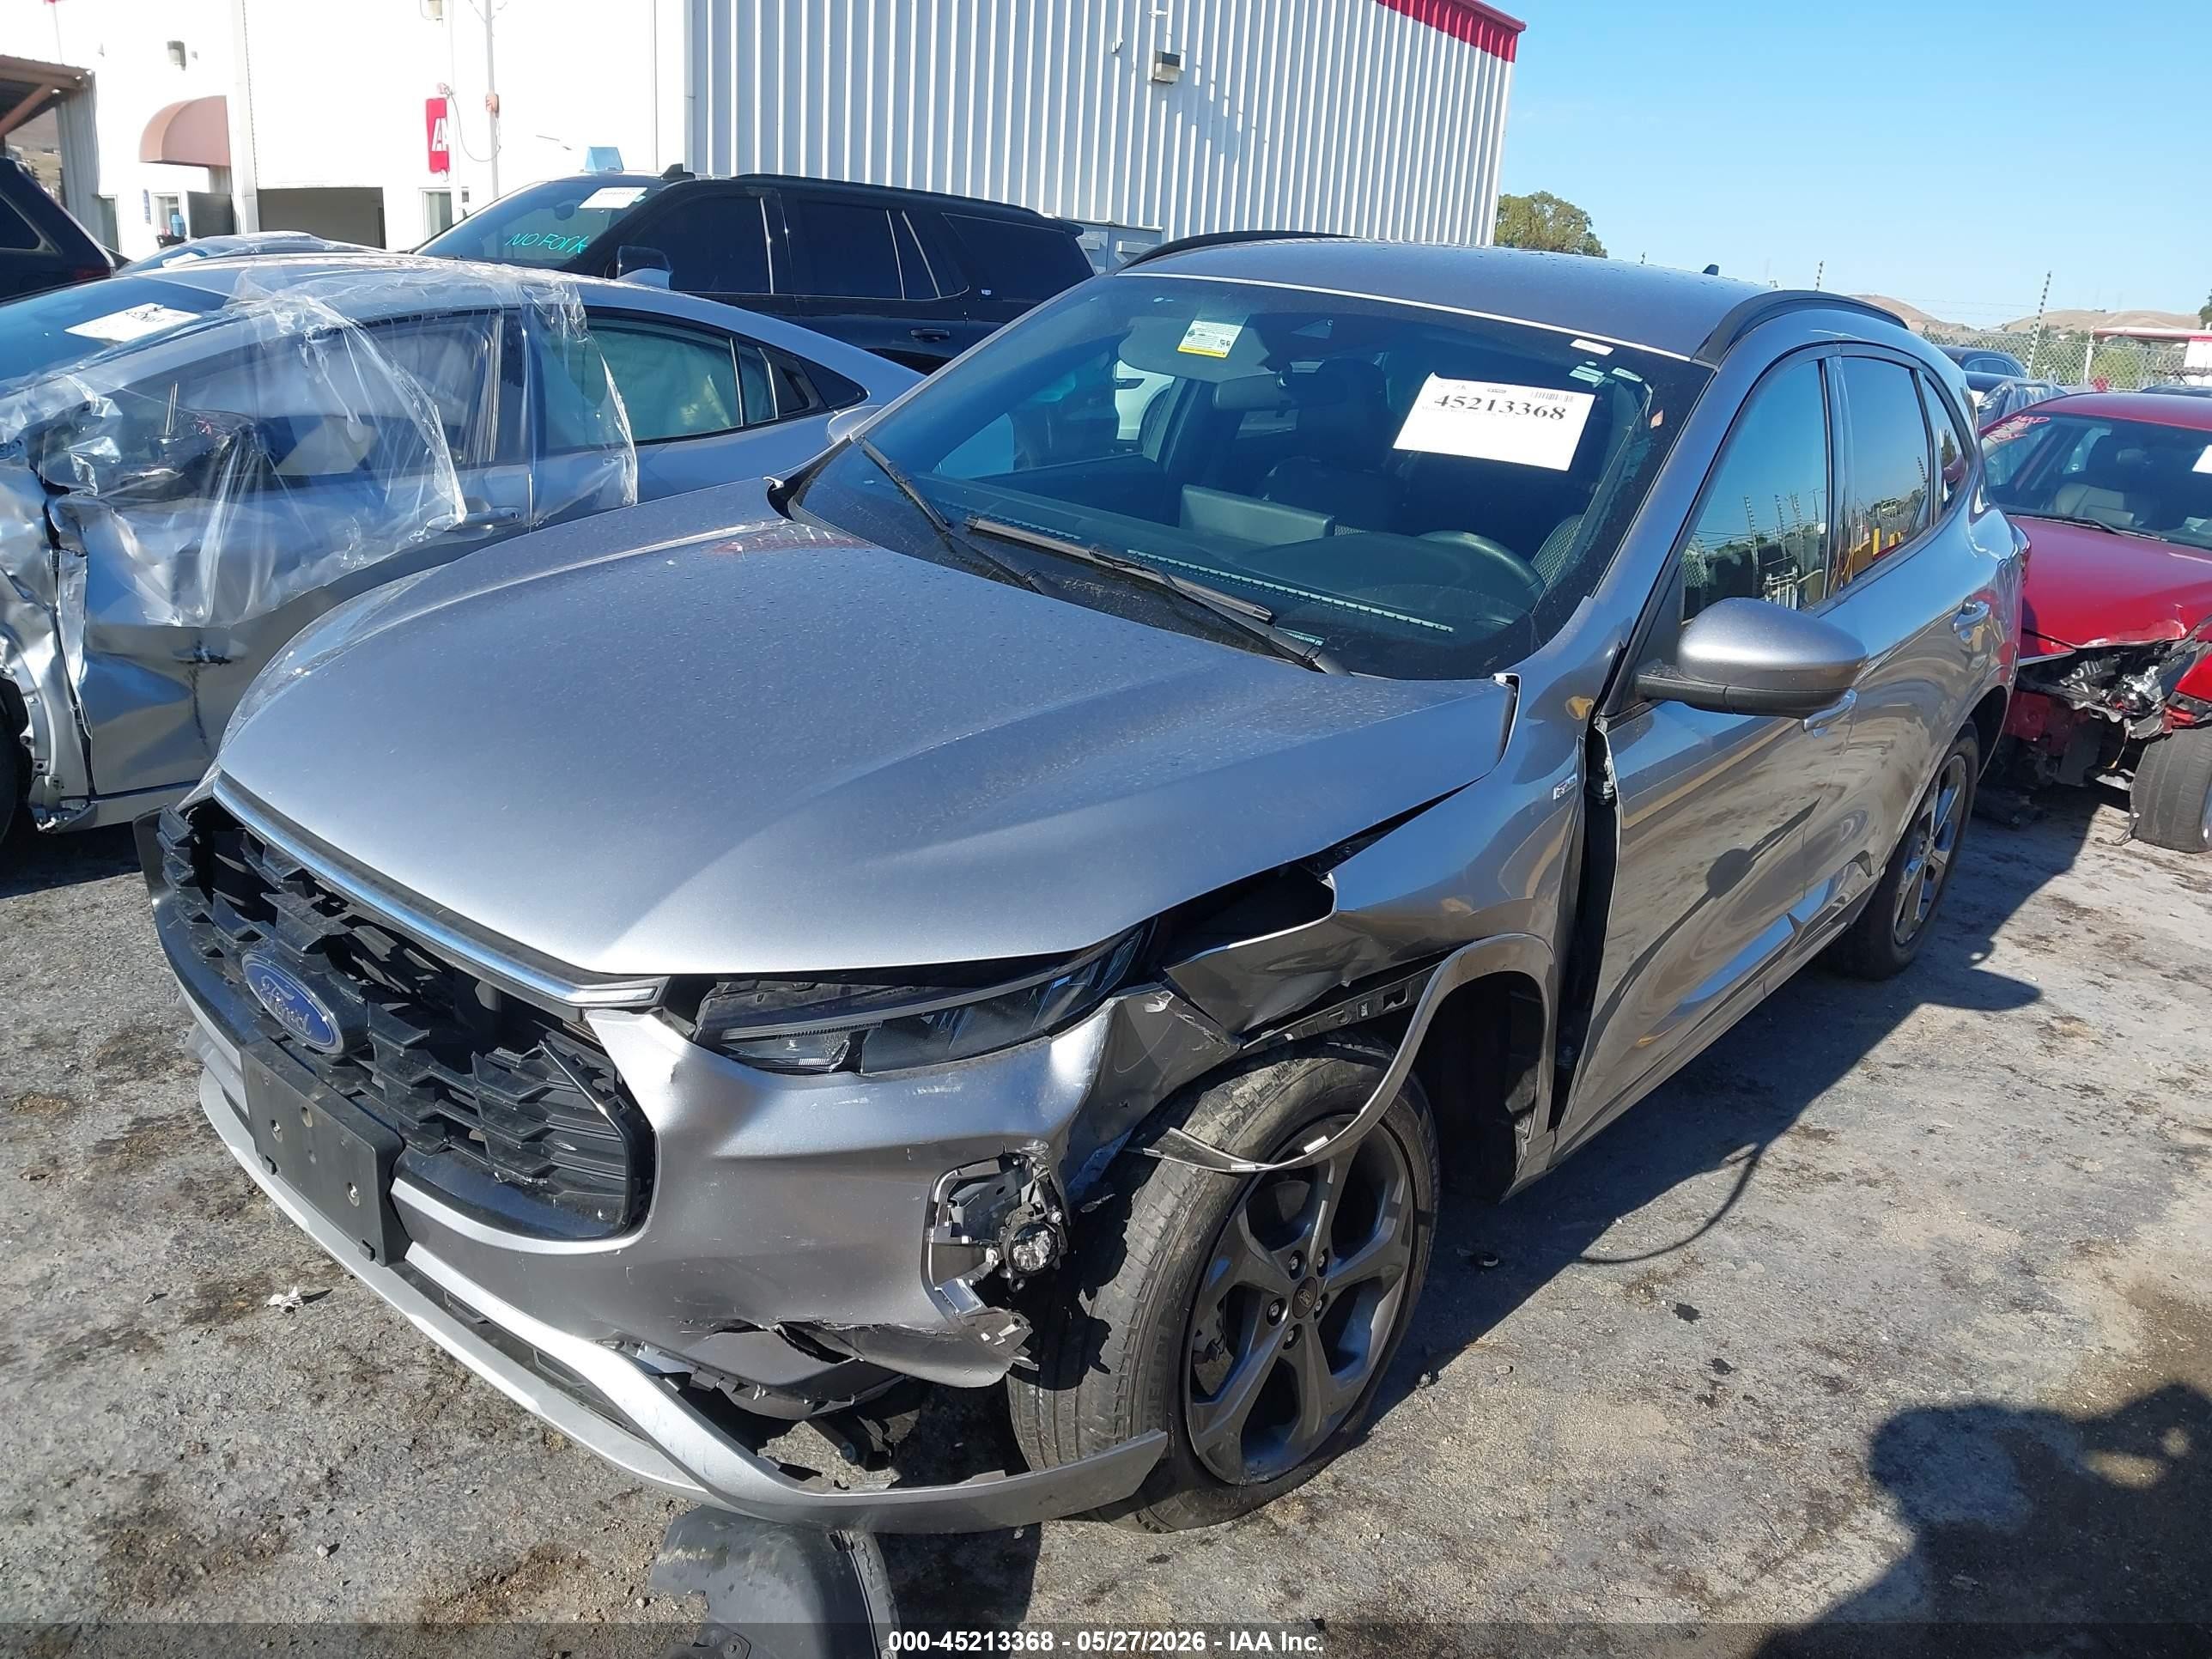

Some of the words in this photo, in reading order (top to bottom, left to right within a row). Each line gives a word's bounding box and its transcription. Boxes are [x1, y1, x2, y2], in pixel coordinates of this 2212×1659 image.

[505, 233, 539, 246] NO
[1434, 394, 1567, 421] 45213368
[260, 975, 312, 1036] Ford
